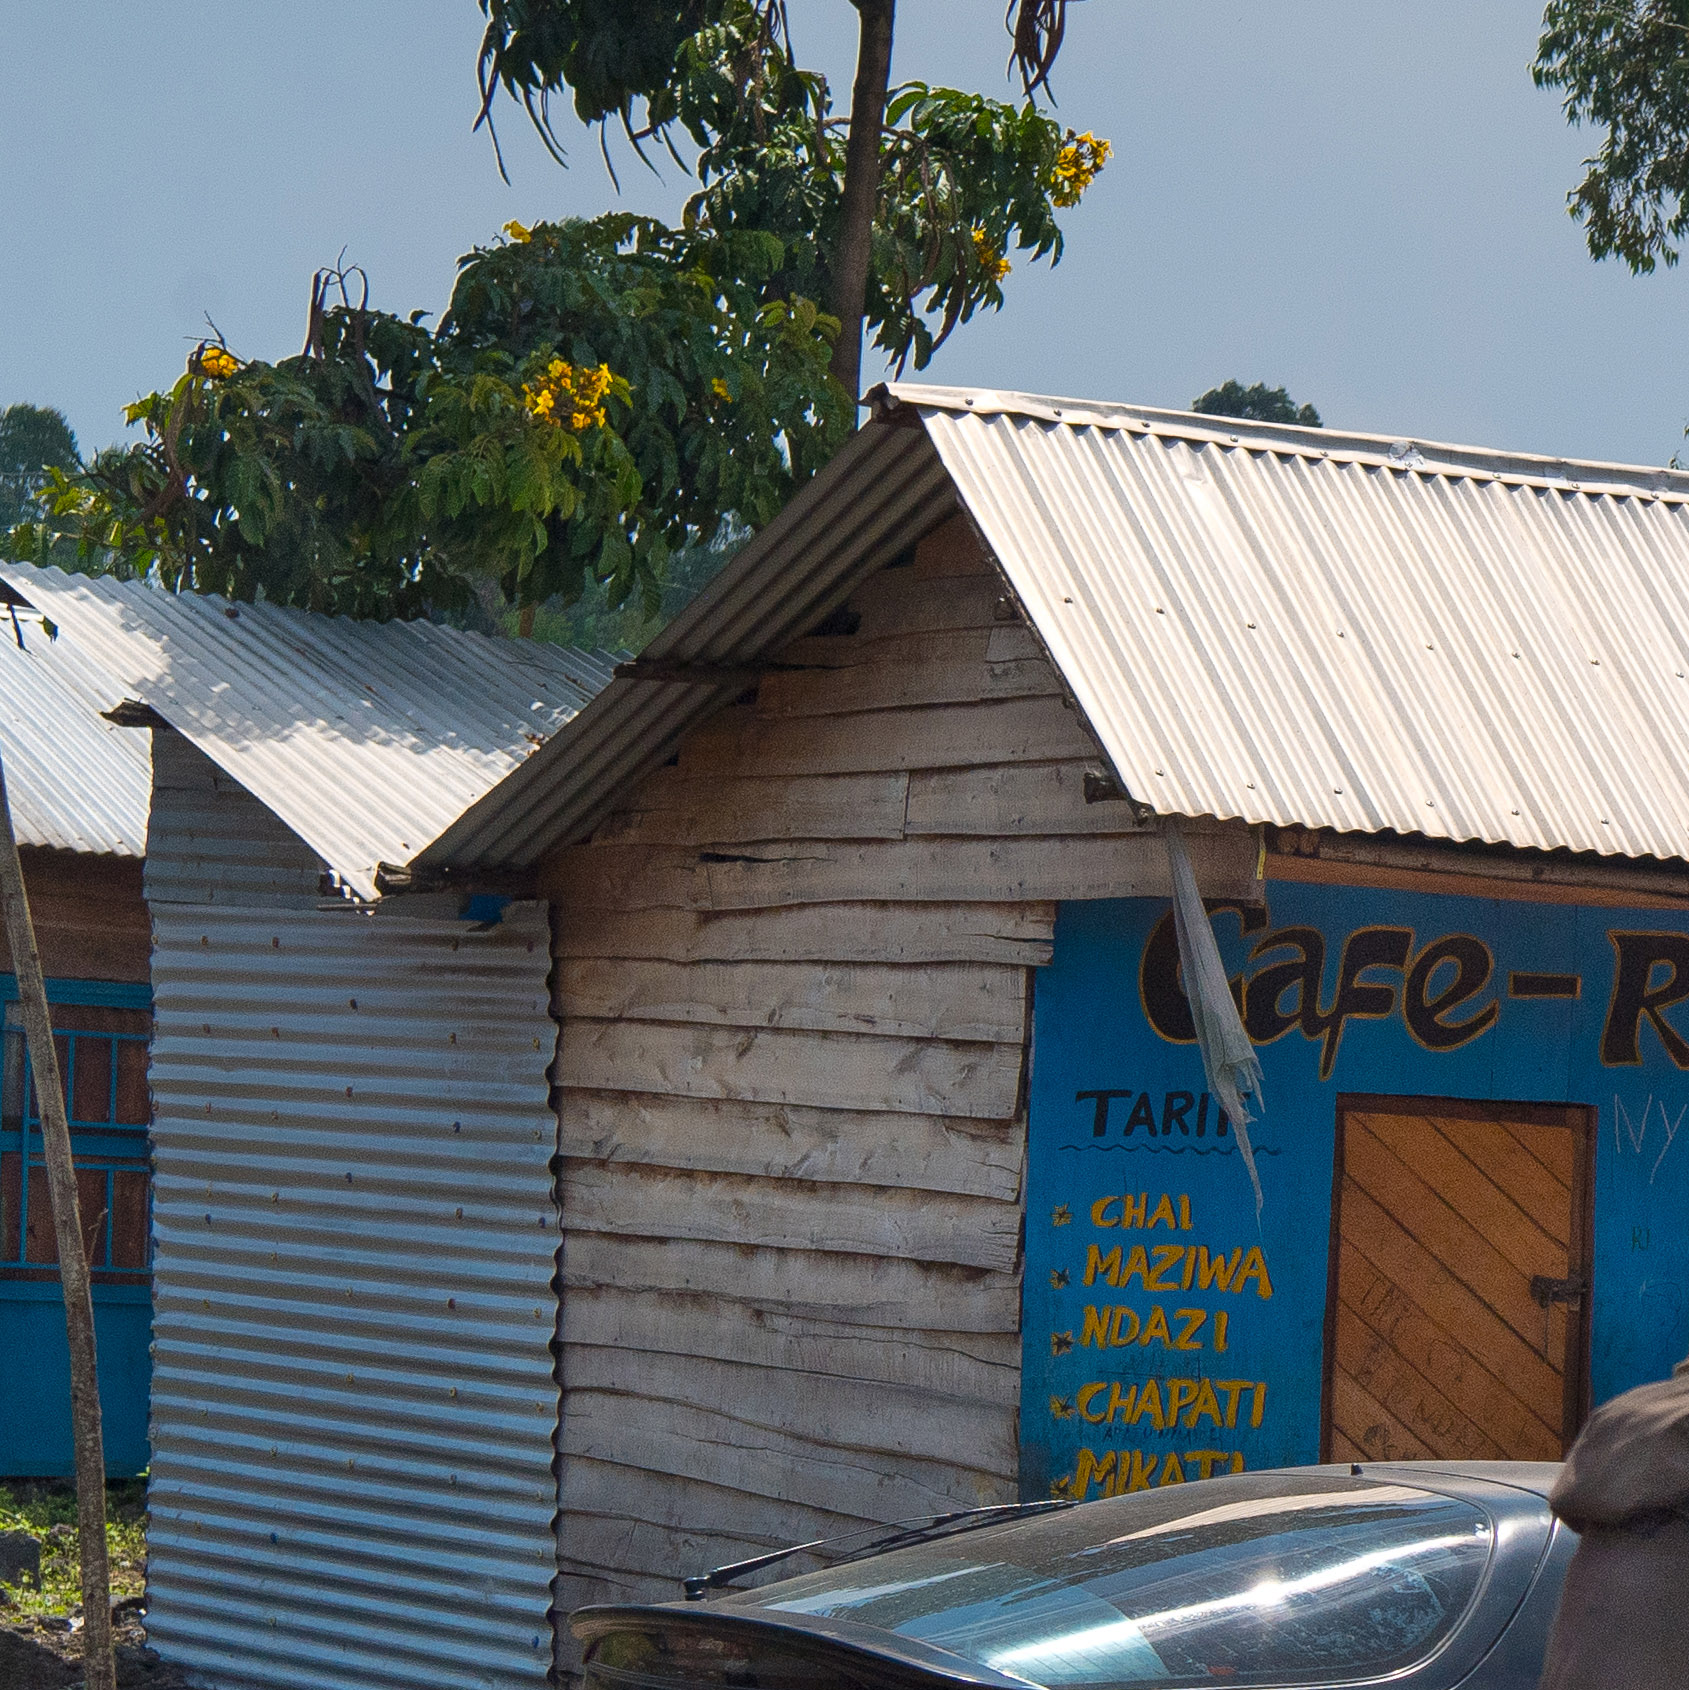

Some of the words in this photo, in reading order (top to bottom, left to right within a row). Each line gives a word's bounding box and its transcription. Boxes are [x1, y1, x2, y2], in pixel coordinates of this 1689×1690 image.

[1090, 1192, 1194, 1231] CHAI
[1082, 1245, 1274, 1299] MAZIWA
[1078, 1304, 1229, 1353] NDAZI
[1076, 1377, 1268, 1430] CHAPATI
